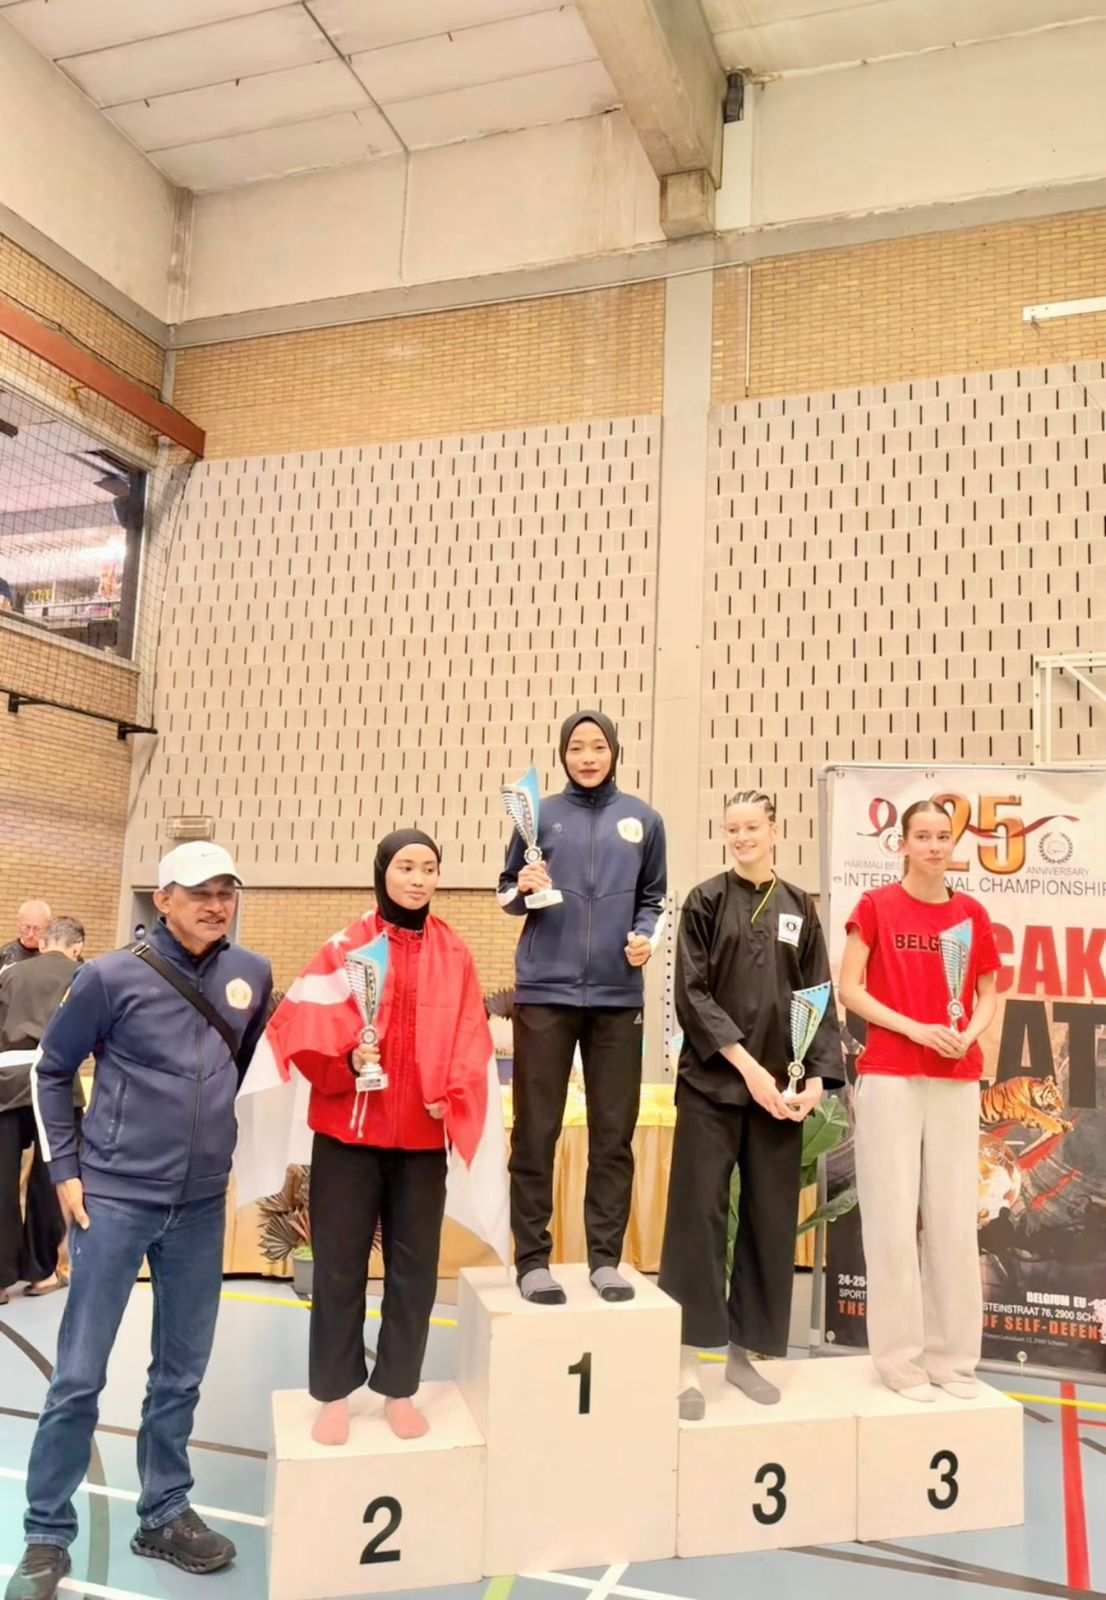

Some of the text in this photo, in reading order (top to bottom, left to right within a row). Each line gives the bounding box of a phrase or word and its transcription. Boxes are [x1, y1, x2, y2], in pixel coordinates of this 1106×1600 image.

[930, 792, 1026, 875] 25
[1026, 866, 1090, 877] ANNIVERSARY
[895, 934, 940, 952] BELG
[991, 922, 1106, 998] CAK
[838, 1300, 865, 1316] THE
[1004, 1315, 1099, 1340] SELF-DEFEN
[839, 1289, 866, 1300] SPORT
[983, 1302, 1039, 1316] STEINSTRAAT
[1055, 1309, 1075, 1320] 2900
[1026, 1291, 1070, 1306] BELGIUM
[568, 1352, 592, 1414] 1
[752, 1462, 787, 1525] 3
[927, 1449, 959, 1510] 3
[359, 1495, 403, 1565] 2
